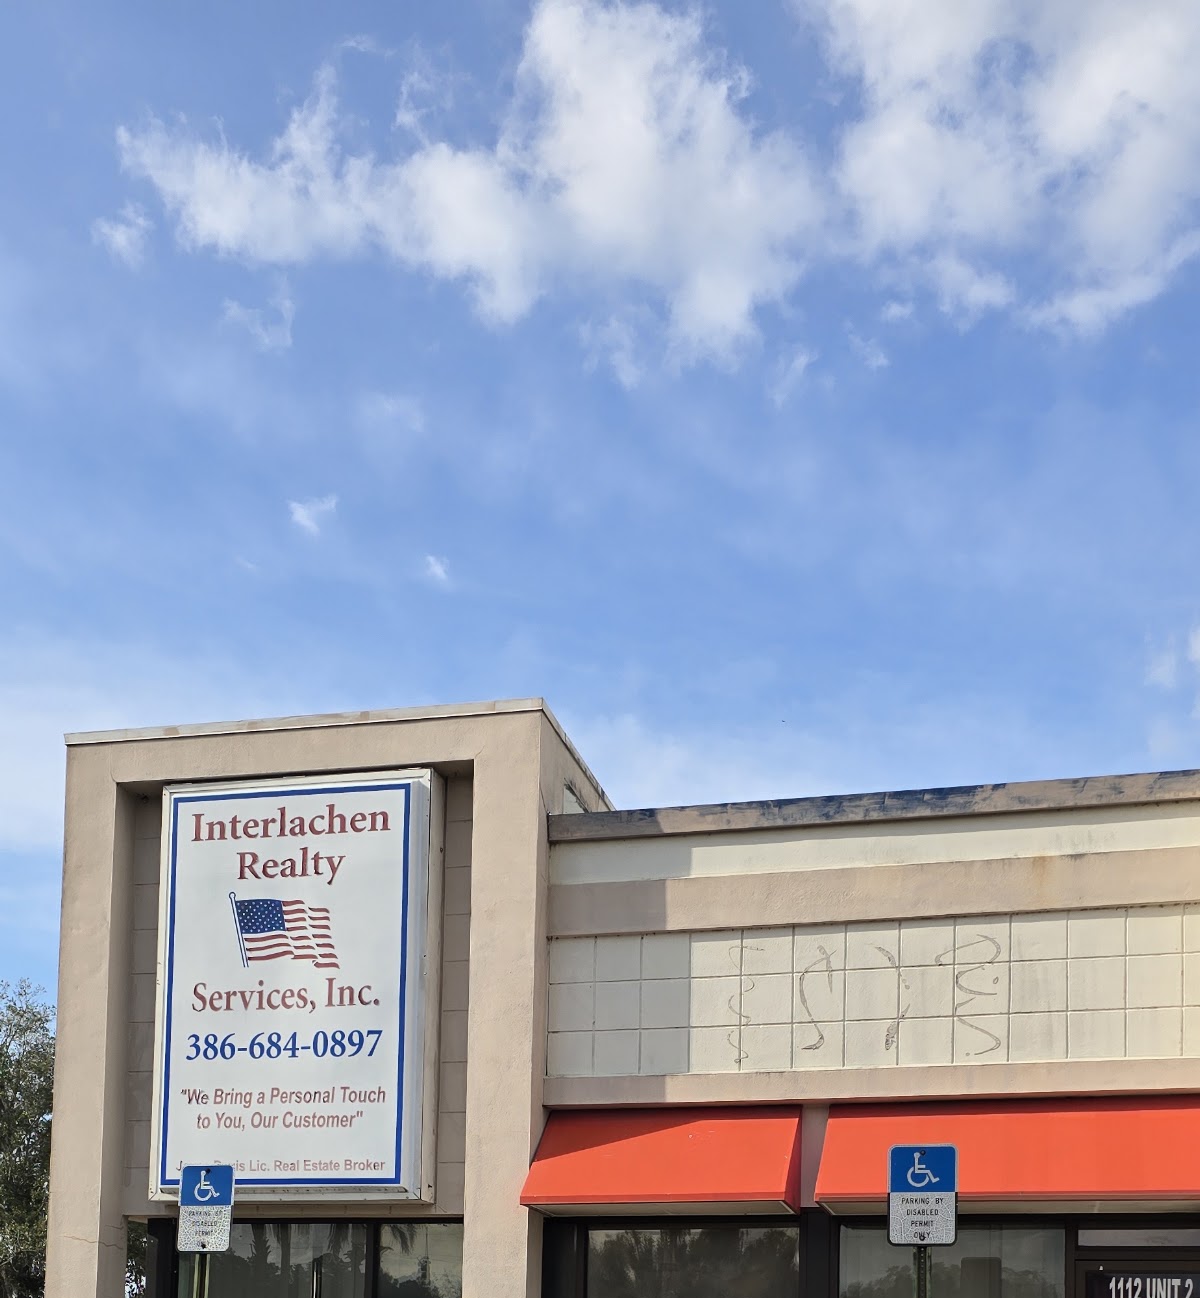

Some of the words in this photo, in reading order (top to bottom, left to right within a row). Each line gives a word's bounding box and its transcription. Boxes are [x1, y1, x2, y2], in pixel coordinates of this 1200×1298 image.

[191, 804, 391, 842] Interlachen
[236, 847, 346, 886] Realty
[191, 979, 316, 1014] Services,
[324, 977, 380, 1007] Inc.
[185, 1029, 383, 1061] 386-684-0897
[213, 1088, 253, 1109] Bring
[256, 1092, 266, 1105] a
[269, 1086, 336, 1105] Personal
[340, 1086, 387, 1104] Touch
[196, 1113, 211, 1129] to
[215, 1112, 246, 1132] You,
[250, 1111, 279, 1129] Our
[282, 1110, 364, 1129] Customer"
[249, 1160, 270, 1172] Lic.
[273, 1160, 300, 1172] Real
[303, 1160, 341, 1172] Estate
[344, 1159, 386, 1172] Broker
[901, 1197, 930, 1205] PARKING
[935, 1197, 944, 1205] BY
[906, 1208, 939, 1216] DISABLED
[910, 1220, 934, 1228] PERMIT
